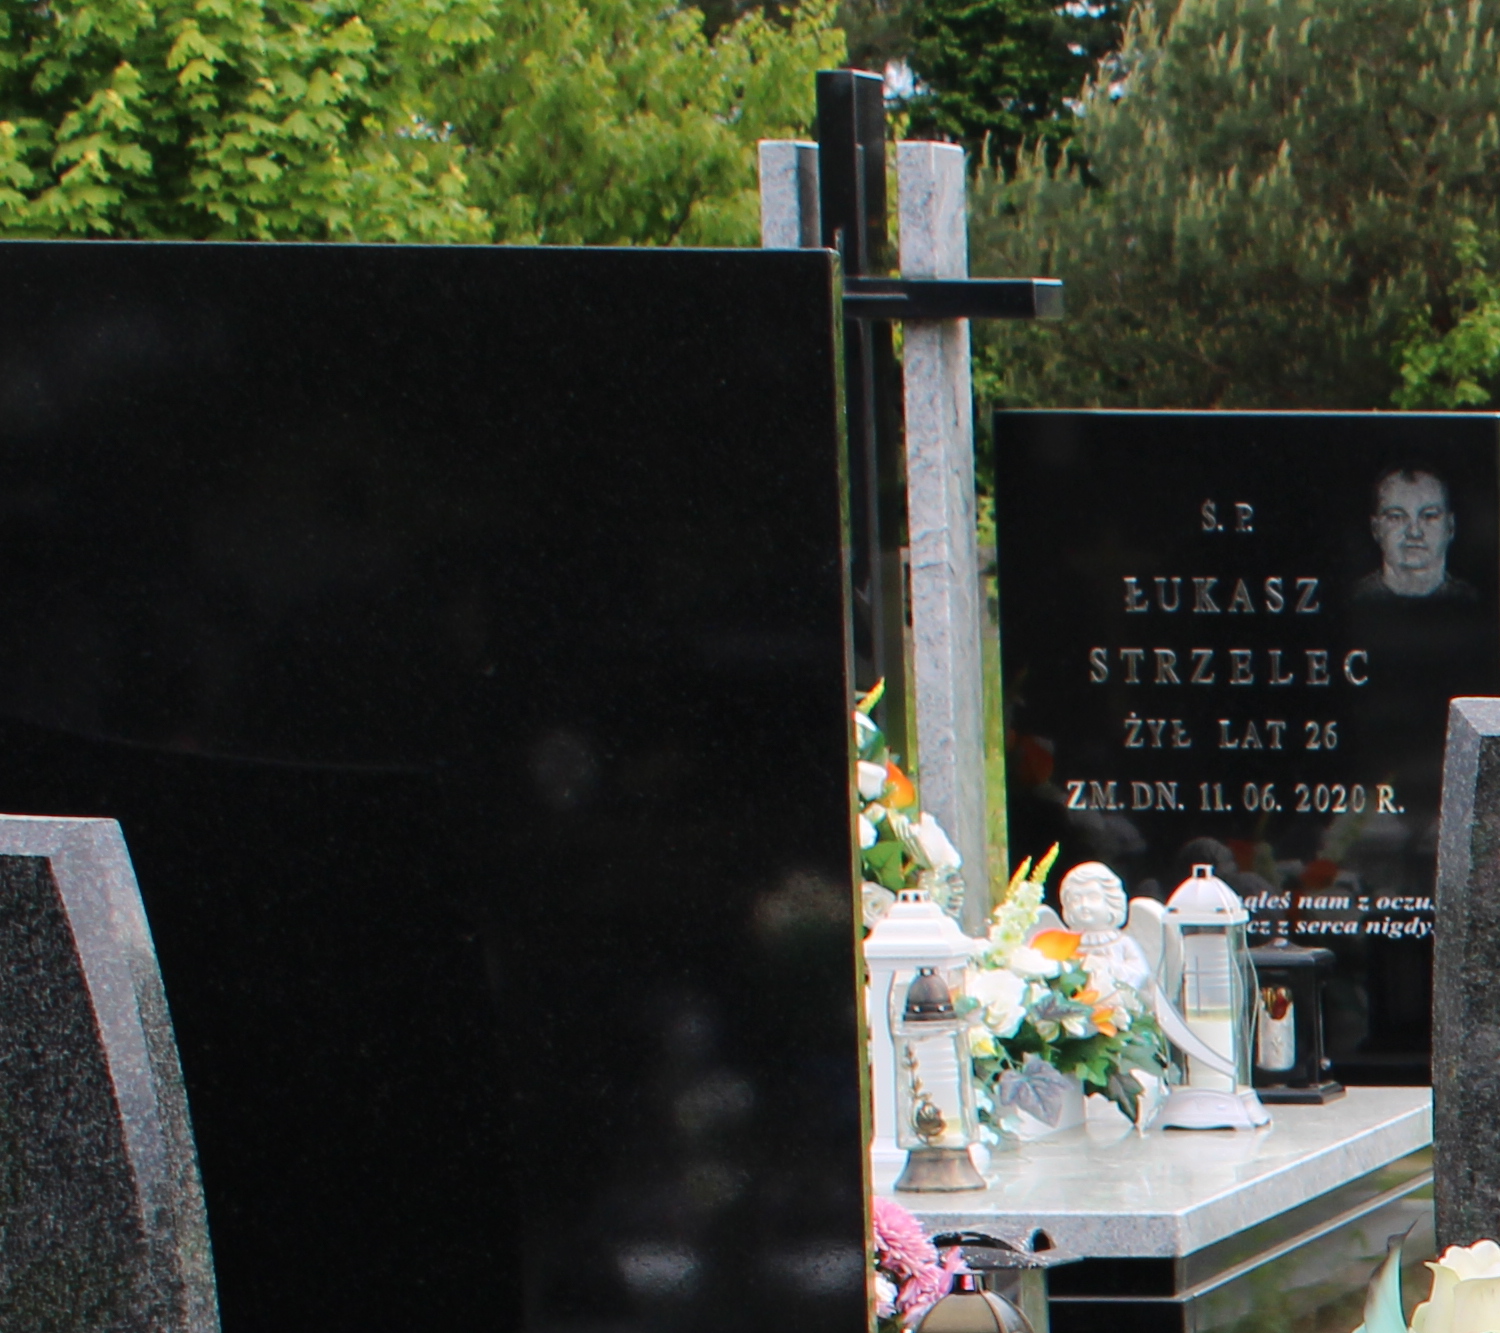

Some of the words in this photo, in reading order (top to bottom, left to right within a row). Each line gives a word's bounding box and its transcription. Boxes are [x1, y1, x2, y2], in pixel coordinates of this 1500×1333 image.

[1123, 576, 1319, 613] ŁUKASZ
[1090, 647, 1369, 685] STRZELEC
[1125, 712, 1191, 748] ŻYŁ
[1219, 719, 1286, 749] LAT
[1305, 721, 1337, 749] 26
[1295, 784, 1366, 813] 2020
[1377, 785, 1405, 813] R.
[1297, 896, 1350, 910] nam
[1357, 896, 1370, 911] z
[1277, 920, 1290, 936] z
[1295, 920, 1358, 935] serca
